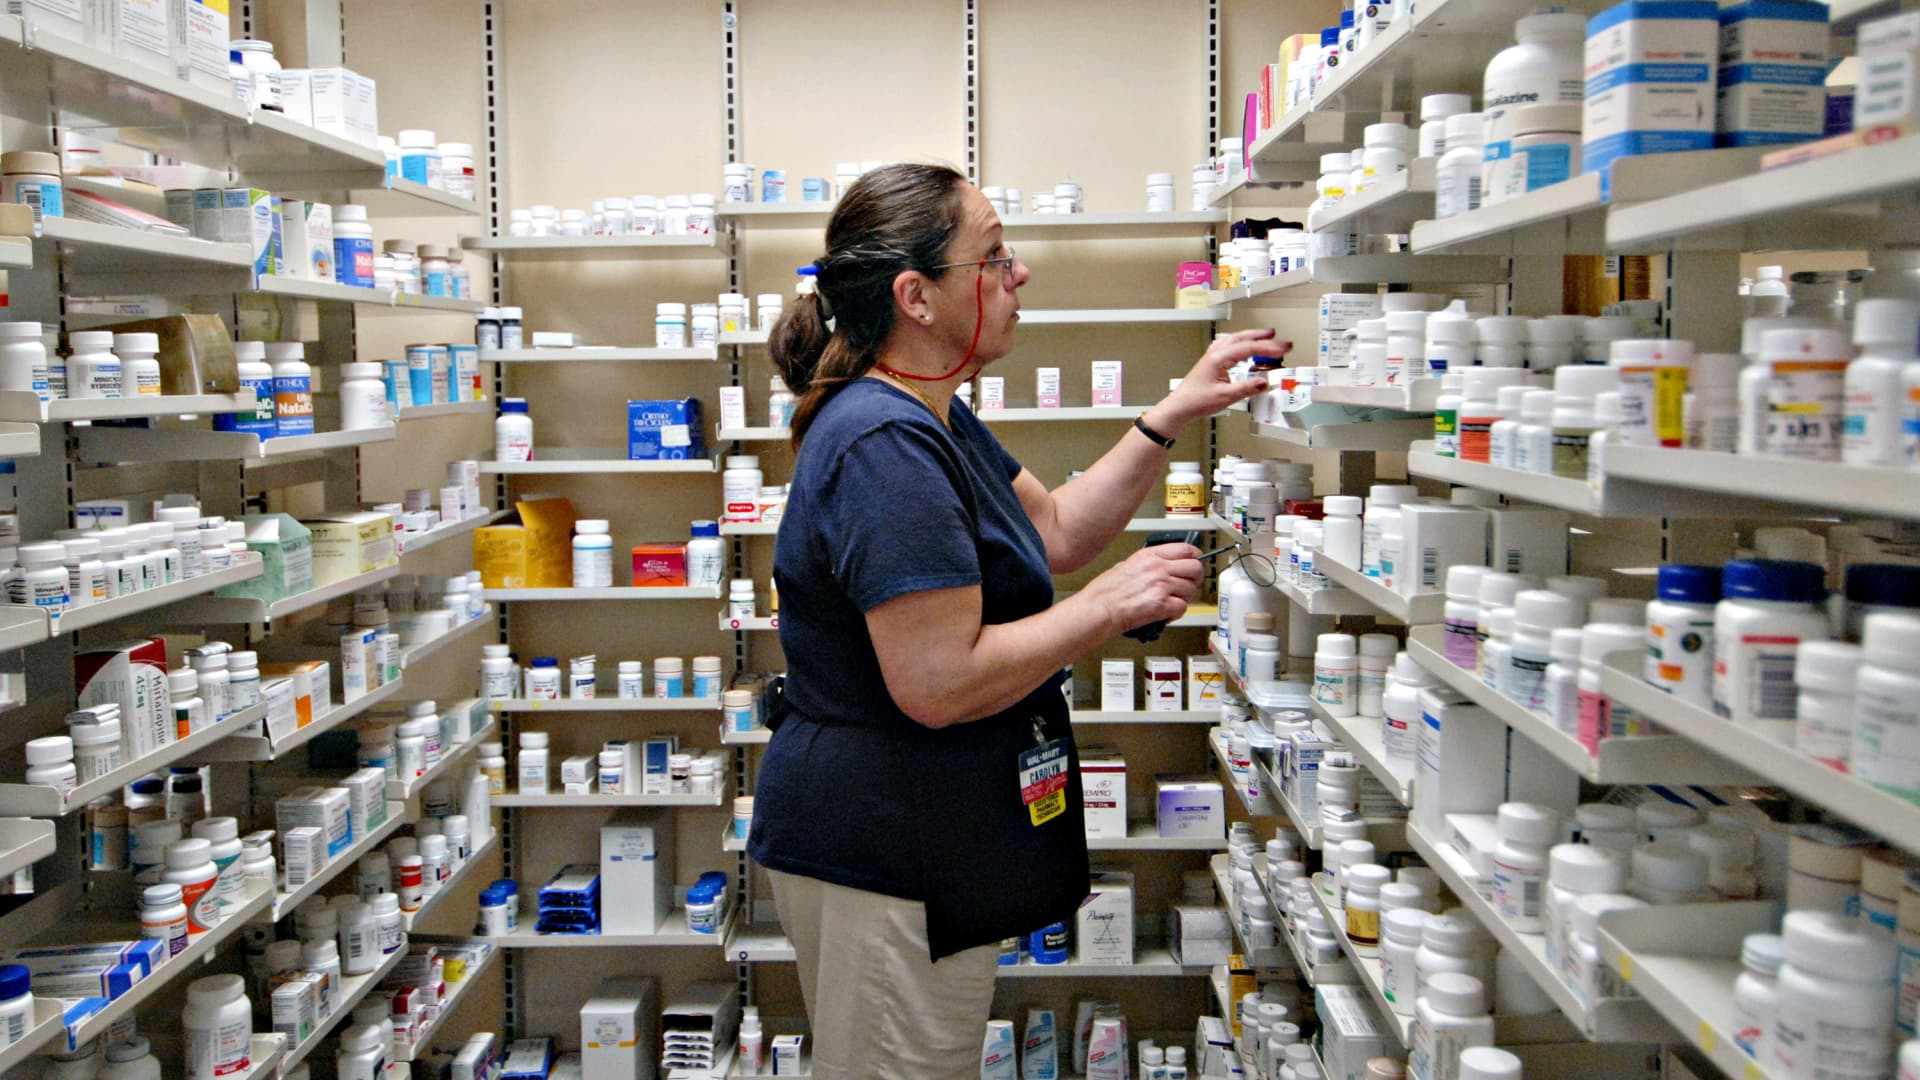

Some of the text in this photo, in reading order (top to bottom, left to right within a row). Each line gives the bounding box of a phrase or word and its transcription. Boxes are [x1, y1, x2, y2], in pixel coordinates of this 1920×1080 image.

[276, 379, 304, 389] ETHEX
[642, 412, 669, 420] ORTHO
[1029, 764, 1061, 785] CAROLYN
